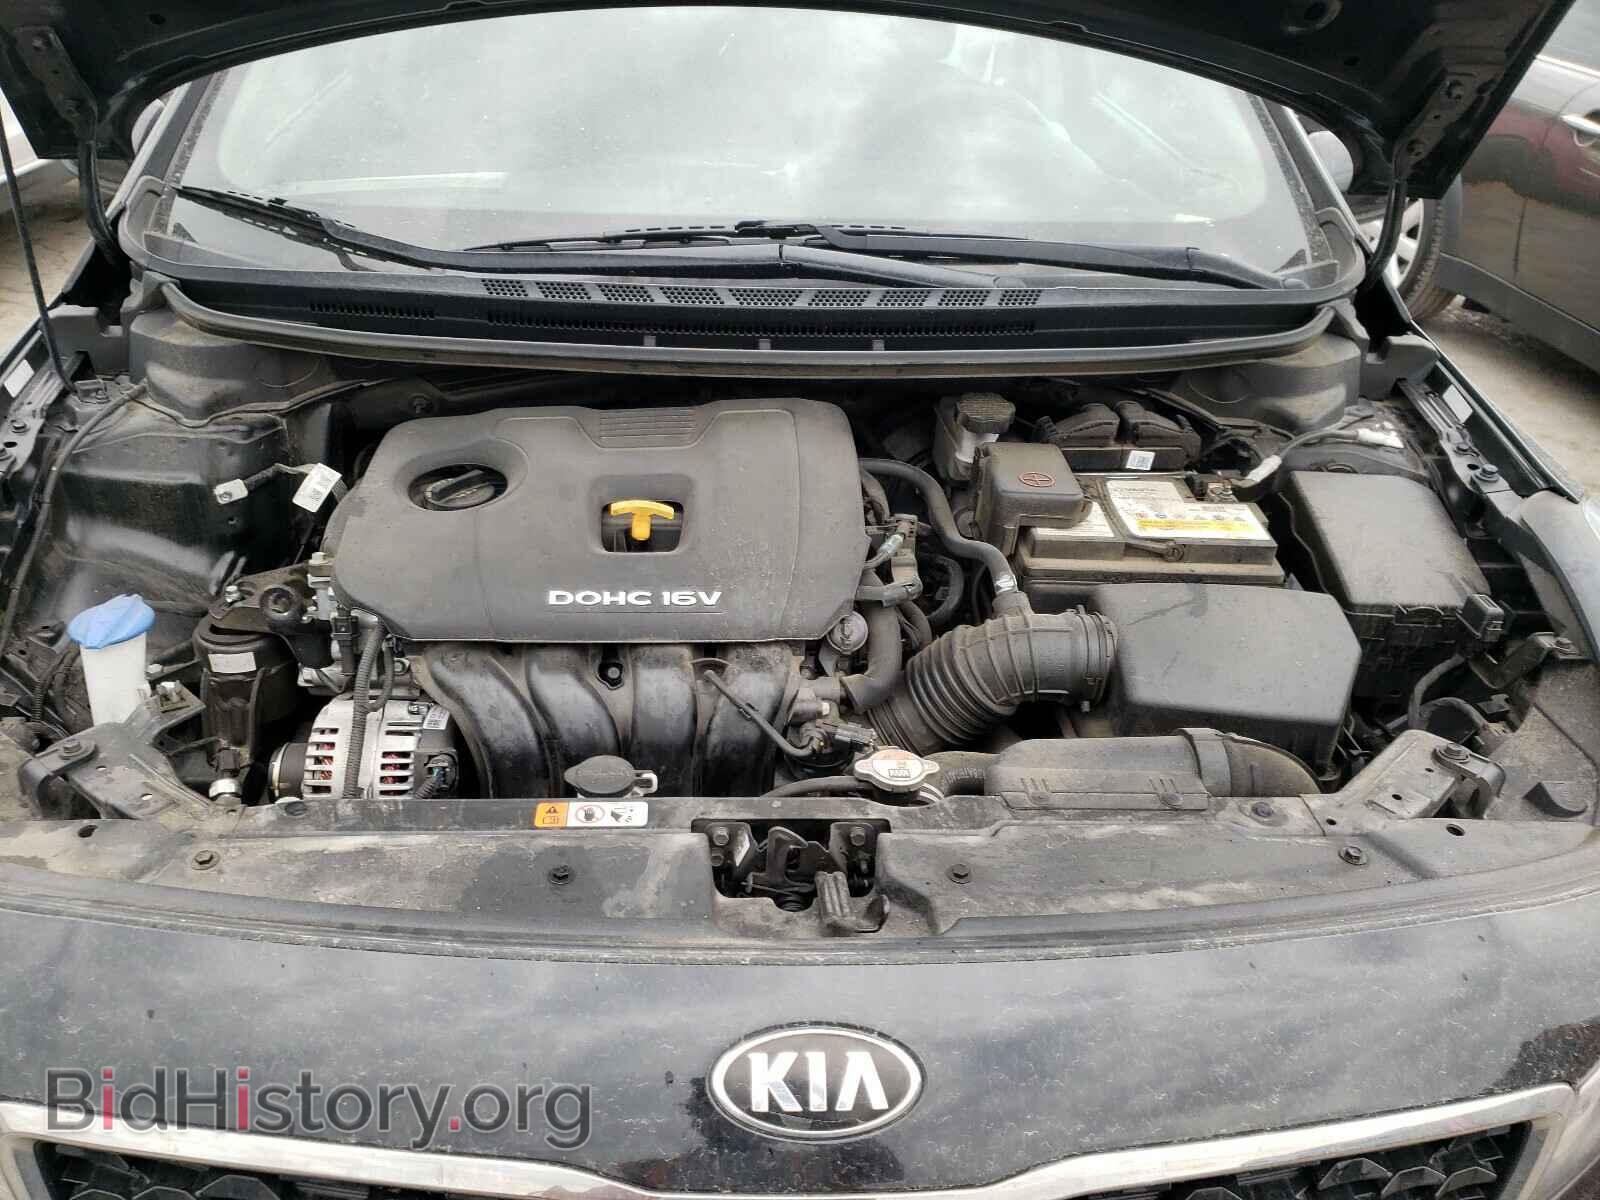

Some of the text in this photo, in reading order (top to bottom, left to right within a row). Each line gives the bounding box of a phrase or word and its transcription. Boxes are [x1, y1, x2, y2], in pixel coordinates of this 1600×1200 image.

[548, 590, 723, 607] DOHC 16V
[748, 1051, 889, 1113] KIA
